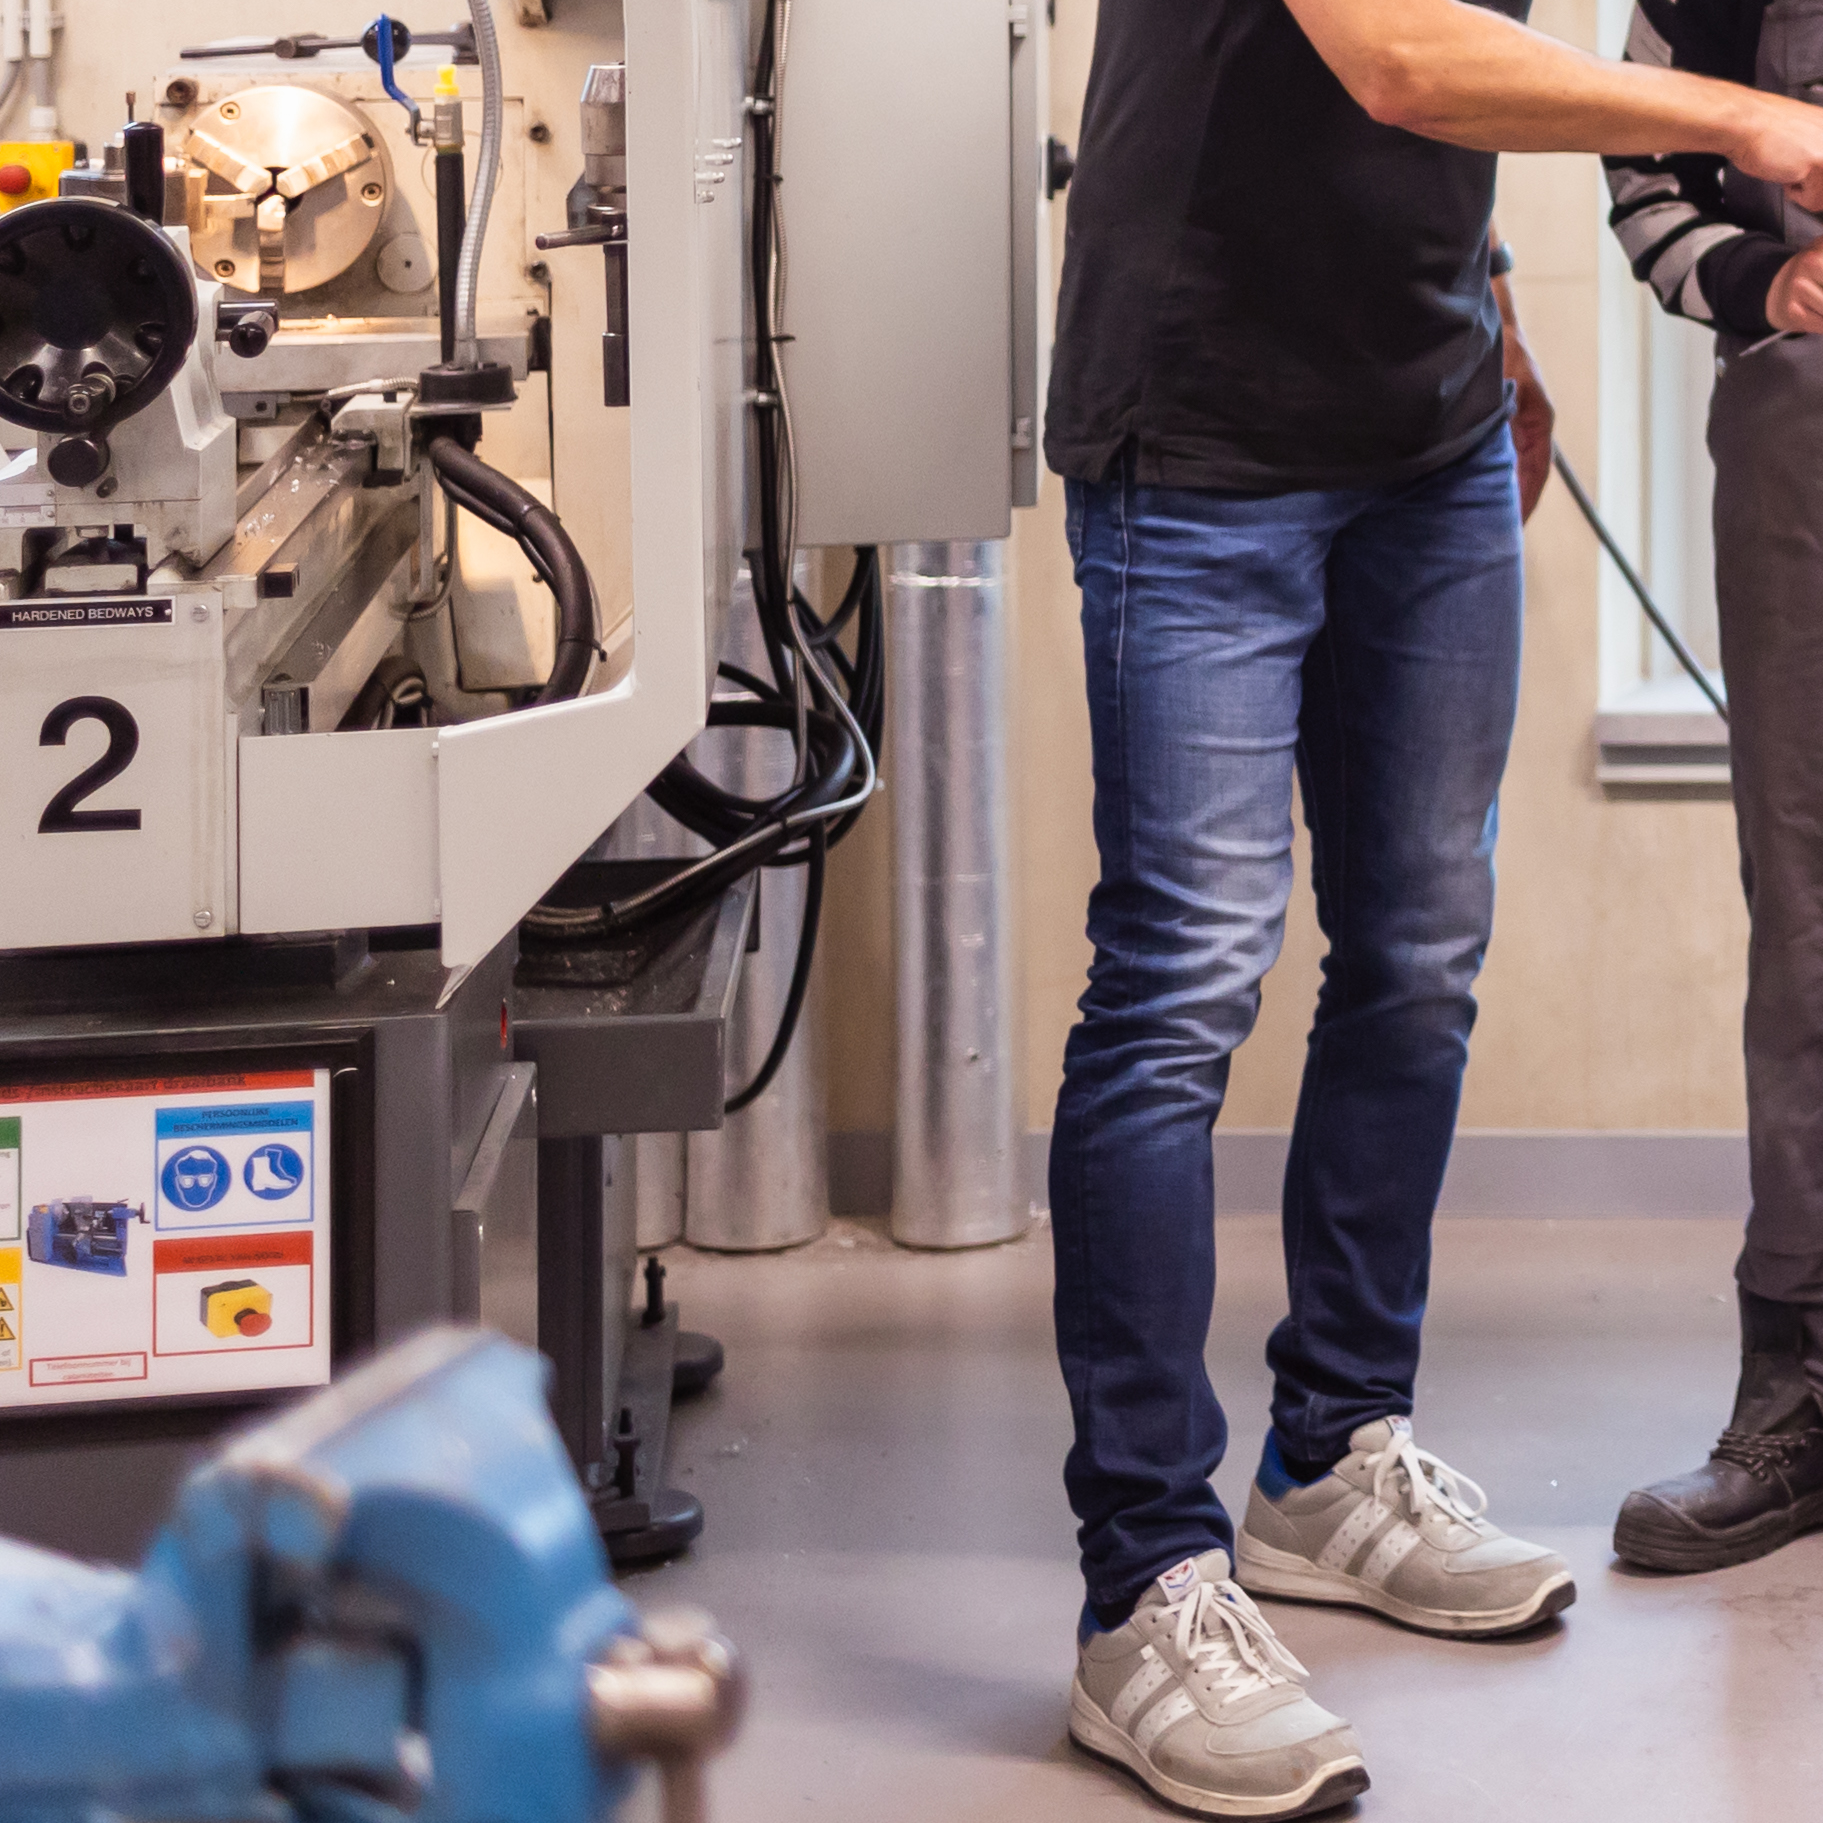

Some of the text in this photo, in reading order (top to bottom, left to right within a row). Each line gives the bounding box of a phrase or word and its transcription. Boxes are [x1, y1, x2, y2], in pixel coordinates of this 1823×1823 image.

[12, 606, 154, 622] HARDENED BEDWAYS
[37, 695, 142, 834] 2
